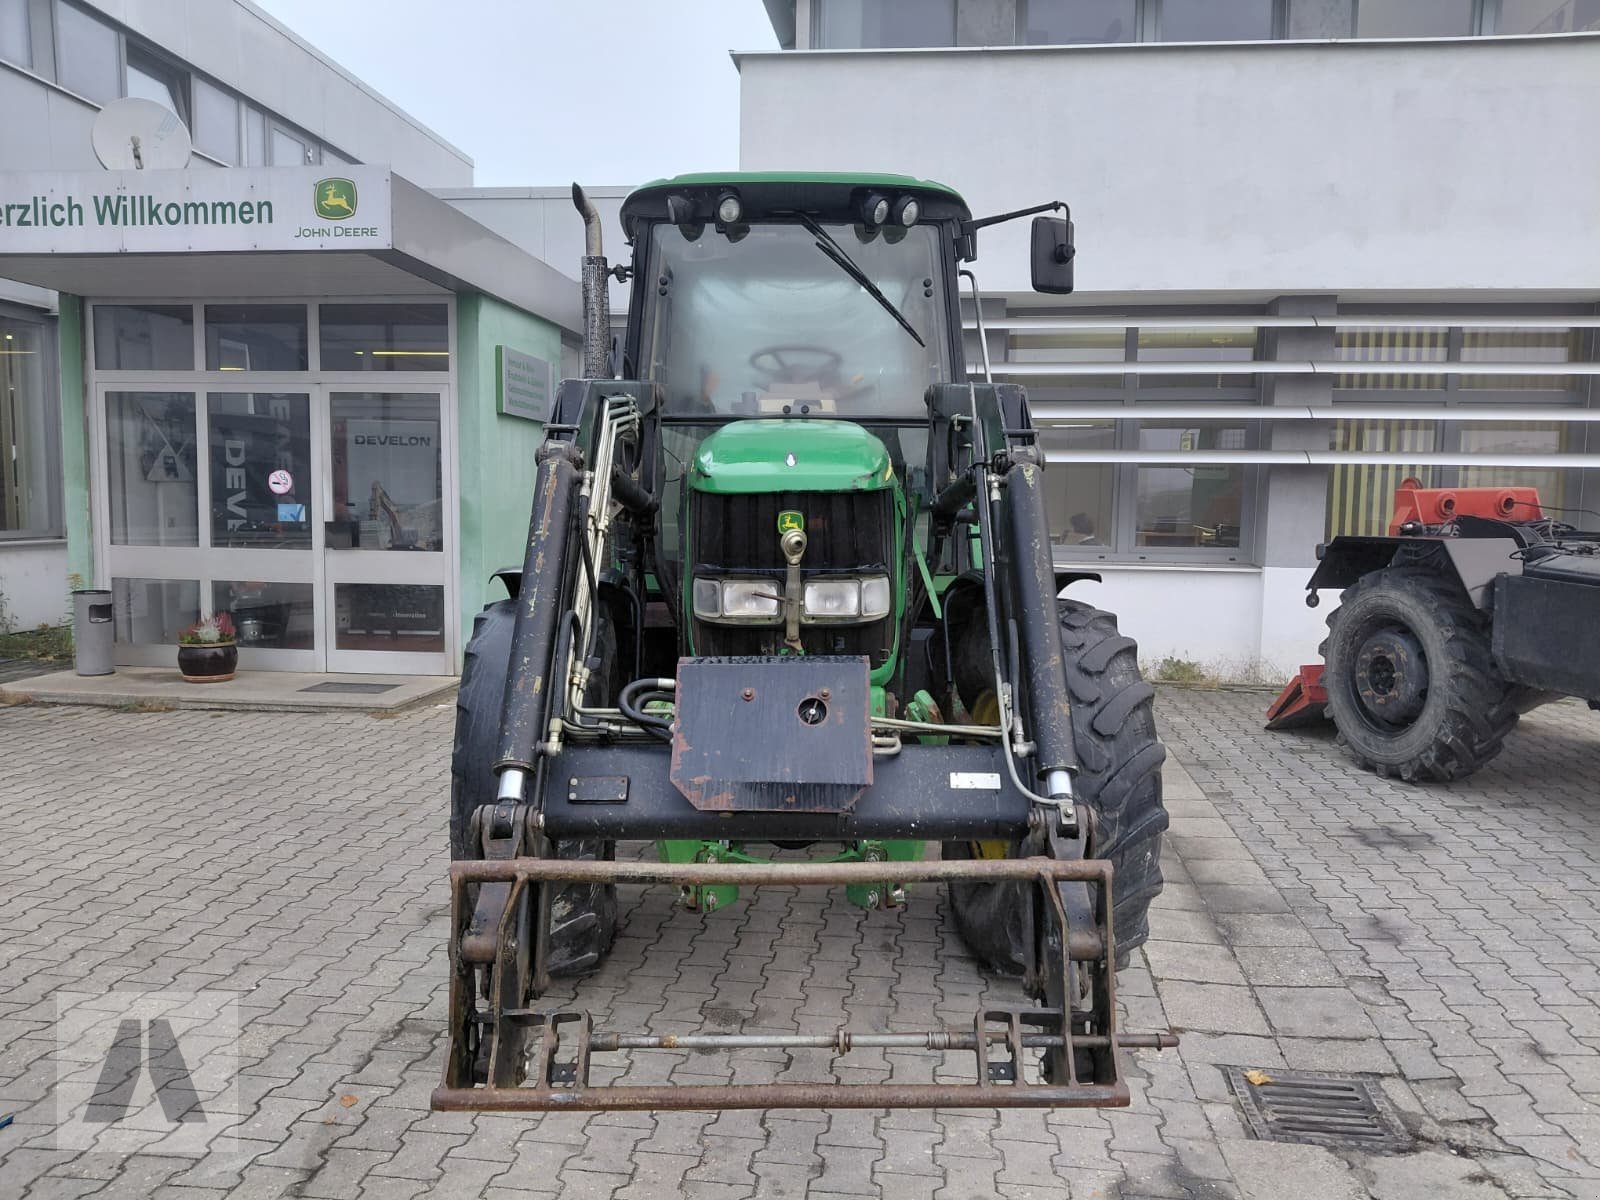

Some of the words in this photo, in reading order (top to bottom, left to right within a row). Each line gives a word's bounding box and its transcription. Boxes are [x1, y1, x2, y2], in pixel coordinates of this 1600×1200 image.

[0, 196, 84, 226] rzlich
[93, 195, 273, 226] Willkommen
[294, 226, 331, 238] JOHN
[333, 226, 378, 237] DEERE
[354, 435, 431, 446] DEVELON
